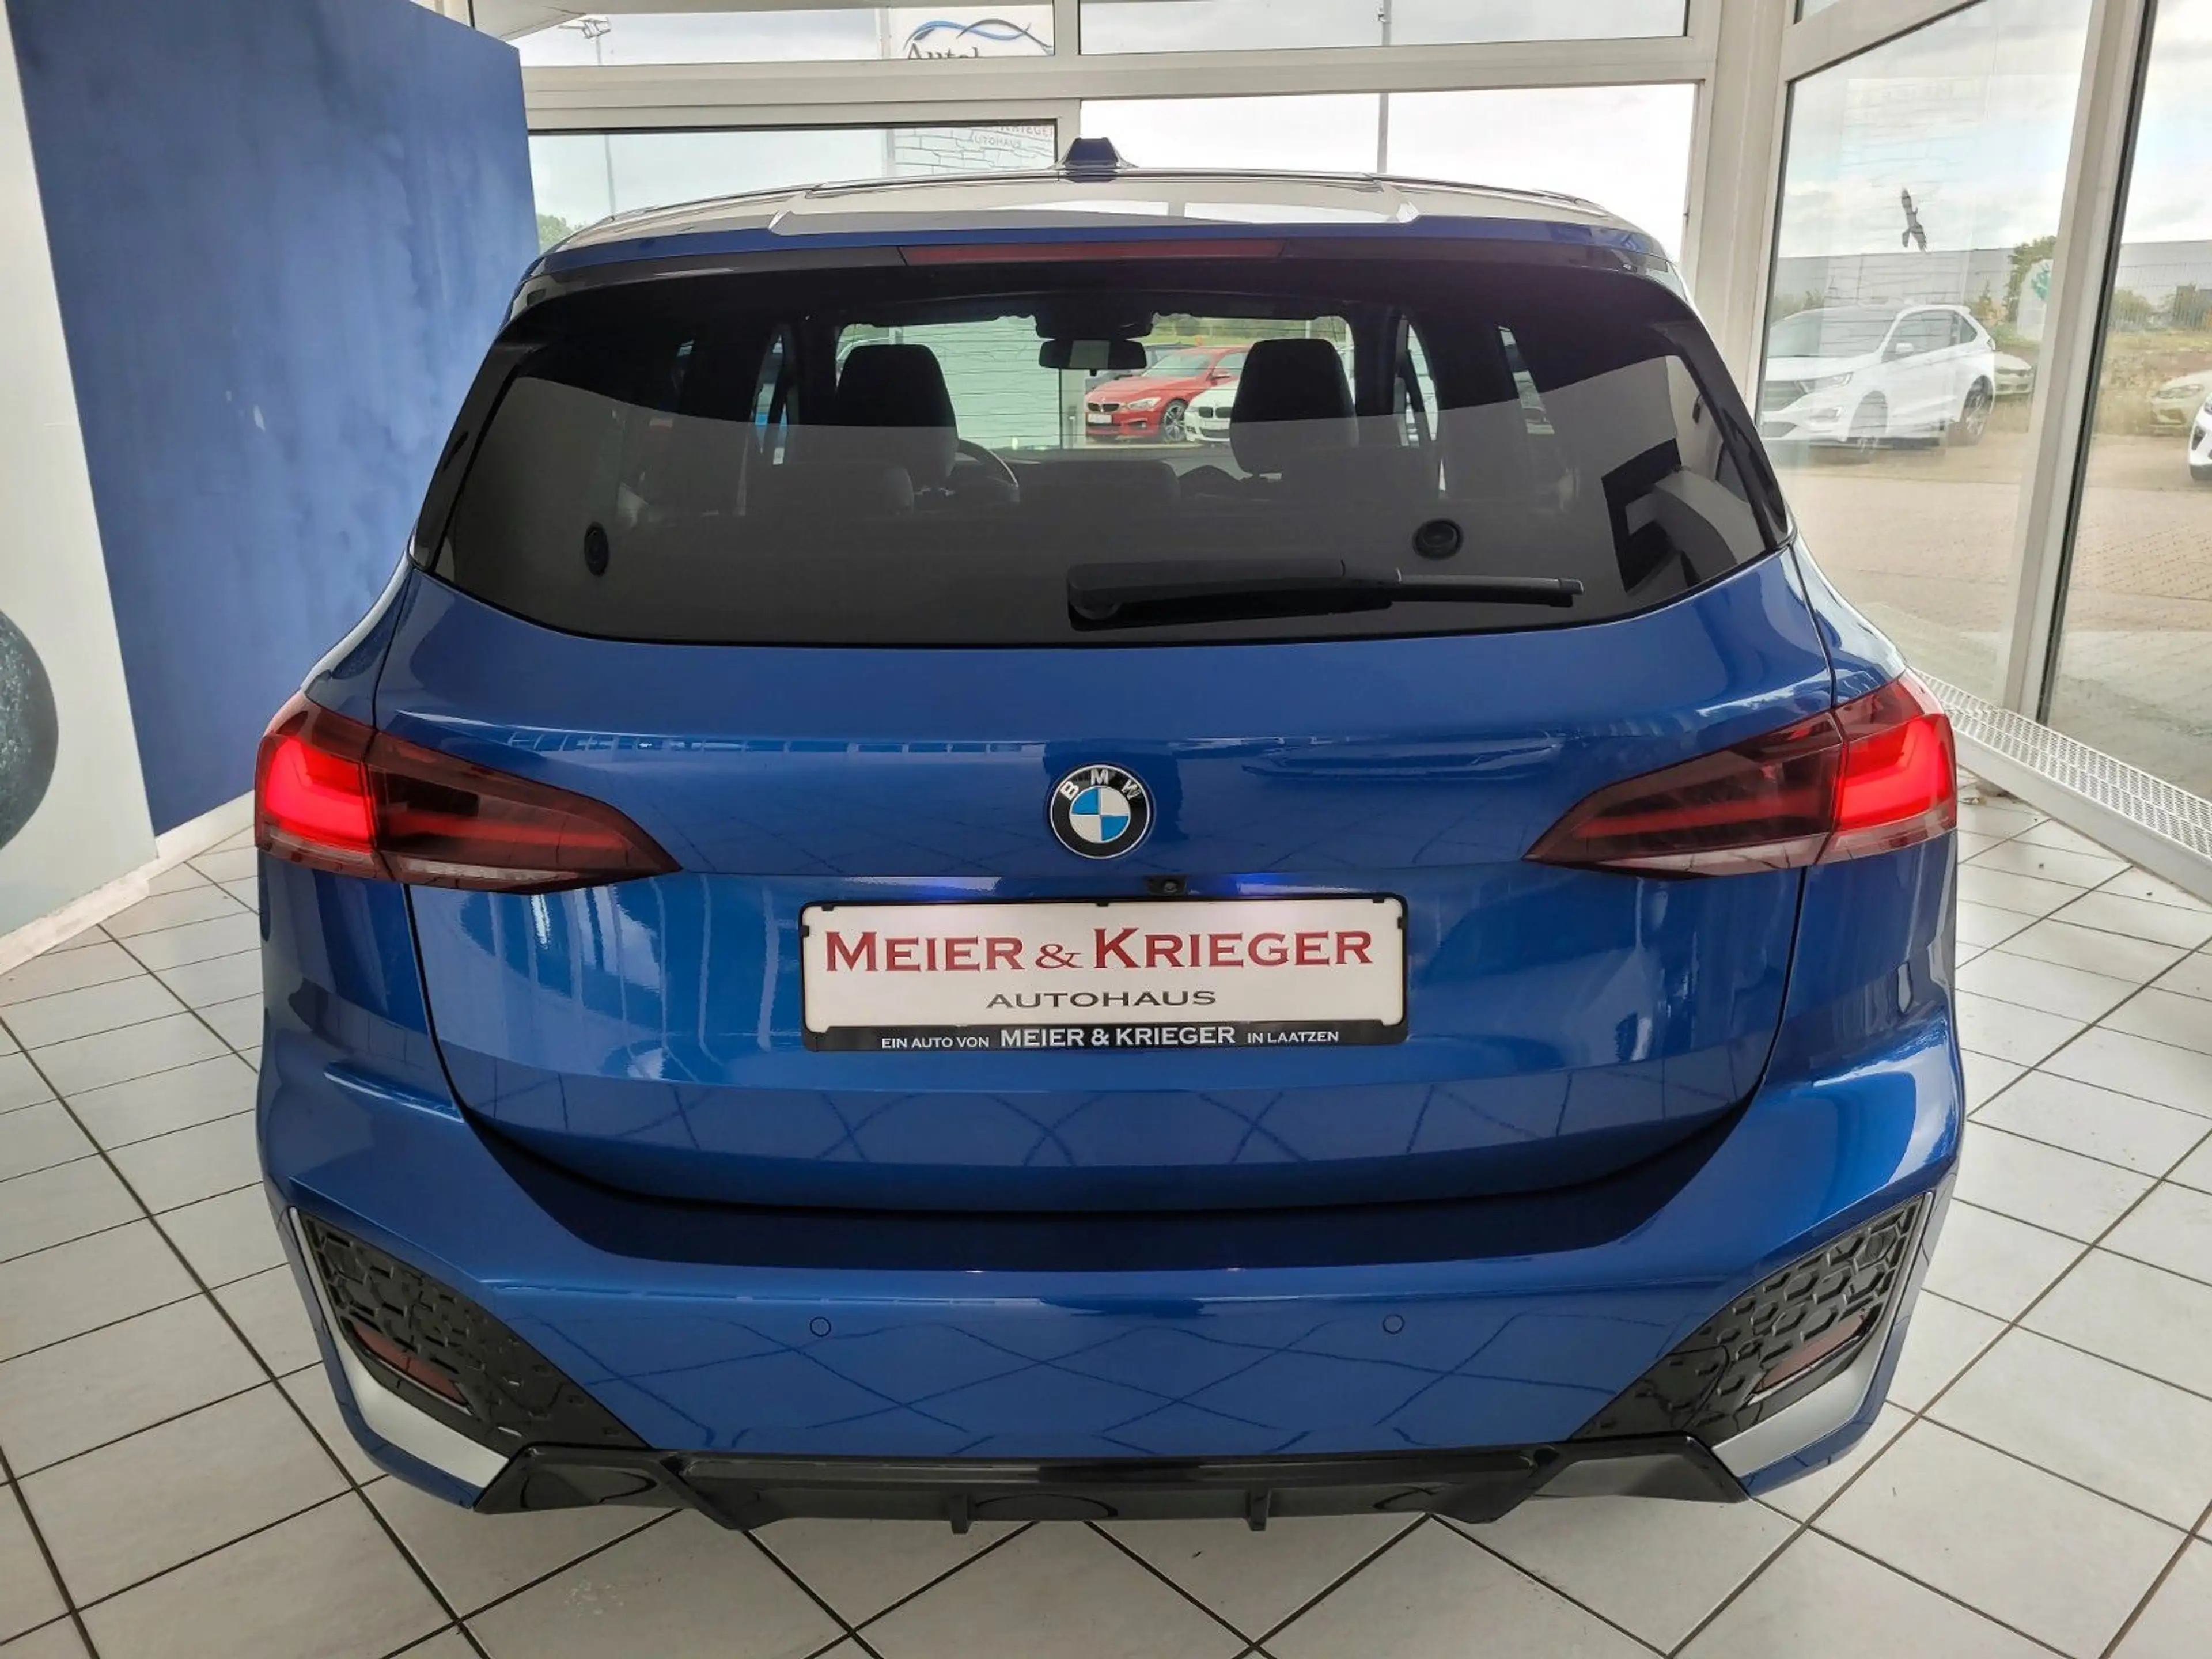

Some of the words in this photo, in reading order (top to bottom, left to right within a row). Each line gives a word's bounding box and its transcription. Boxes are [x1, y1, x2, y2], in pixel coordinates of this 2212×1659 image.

[1060, 768, 1142, 800] BMW
[825, 931, 1024, 974] MEIER
[1035, 944, 1082, 969] &
[1094, 927, 1373, 970] KRIEGER
[986, 990, 1217, 1009] AUTOHAUS
[881, 1037, 908, 1049] EIN
[911, 1037, 953, 1048] AUTO
[956, 1036, 990, 1048] VON
[1001, 1028, 1085, 1047] MEIER
[1091, 1028, 1109, 1046] &
[1116, 1026, 1236, 1046] KRIEGER
[1247, 1032, 1264, 1044] IN
[1267, 1031, 1339, 1043] LAATZEN
